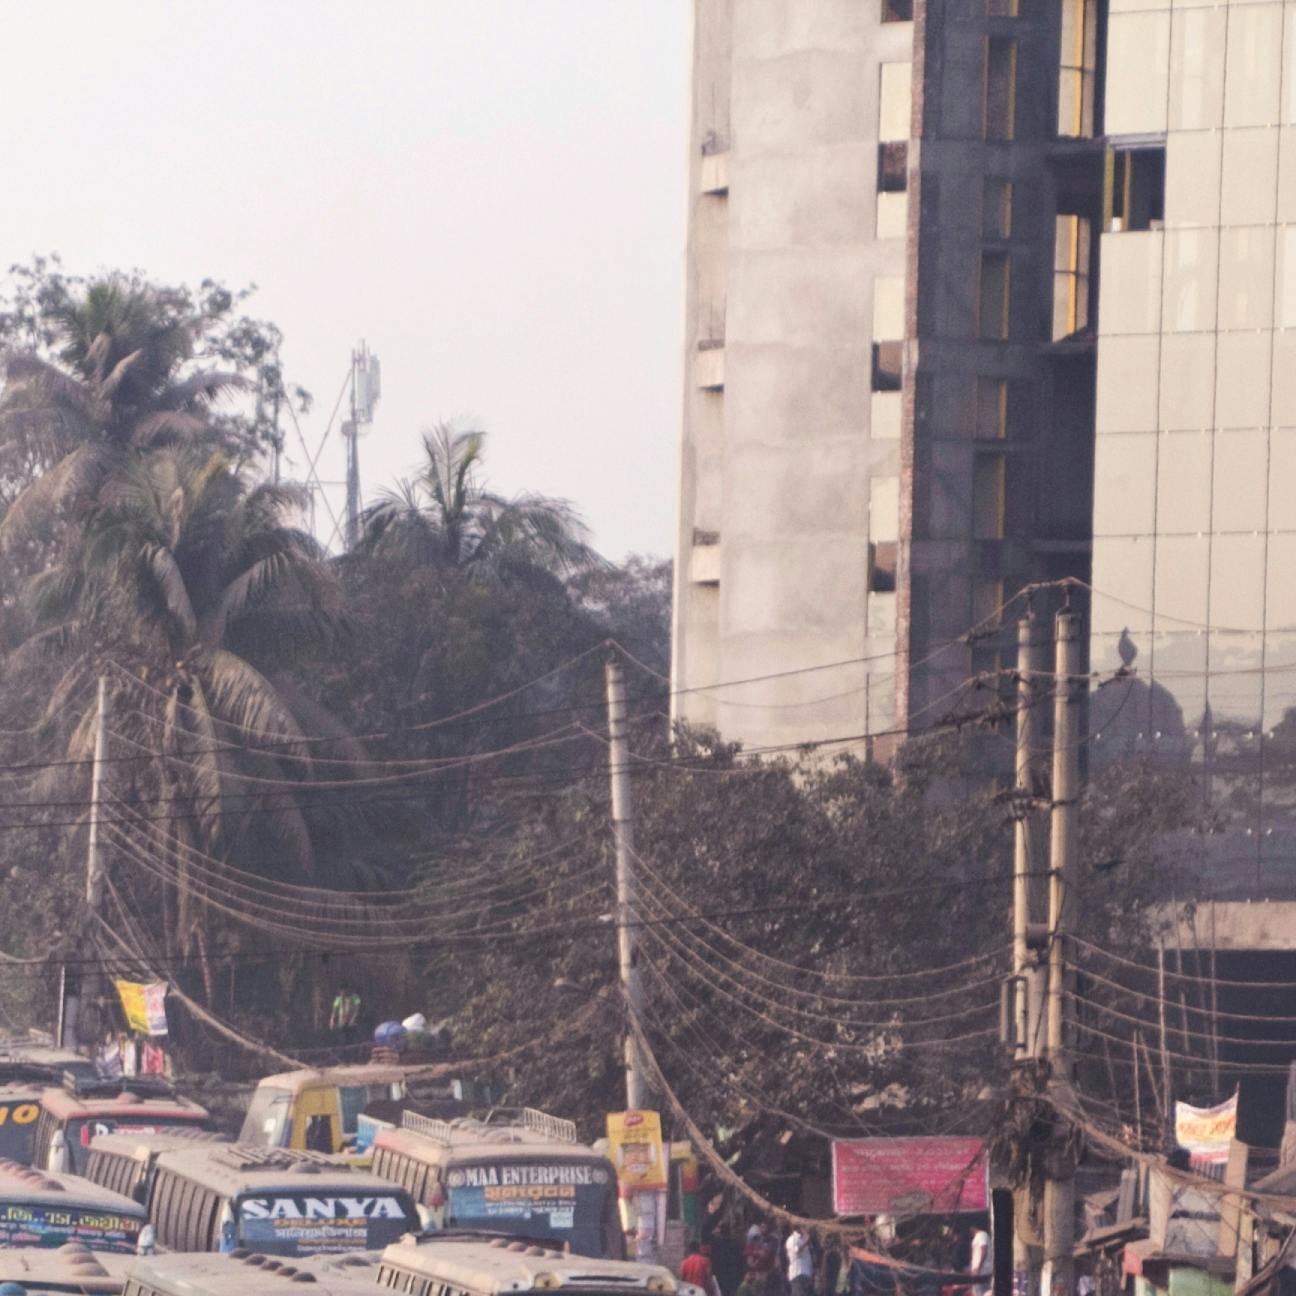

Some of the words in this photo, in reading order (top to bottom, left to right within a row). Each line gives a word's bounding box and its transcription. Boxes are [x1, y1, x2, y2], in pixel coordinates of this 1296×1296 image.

[466, 1166, 498, 1186] MAA
[502, 1166, 593, 1185] ENTERPRISE
[241, 1197, 407, 1219] SANYA
